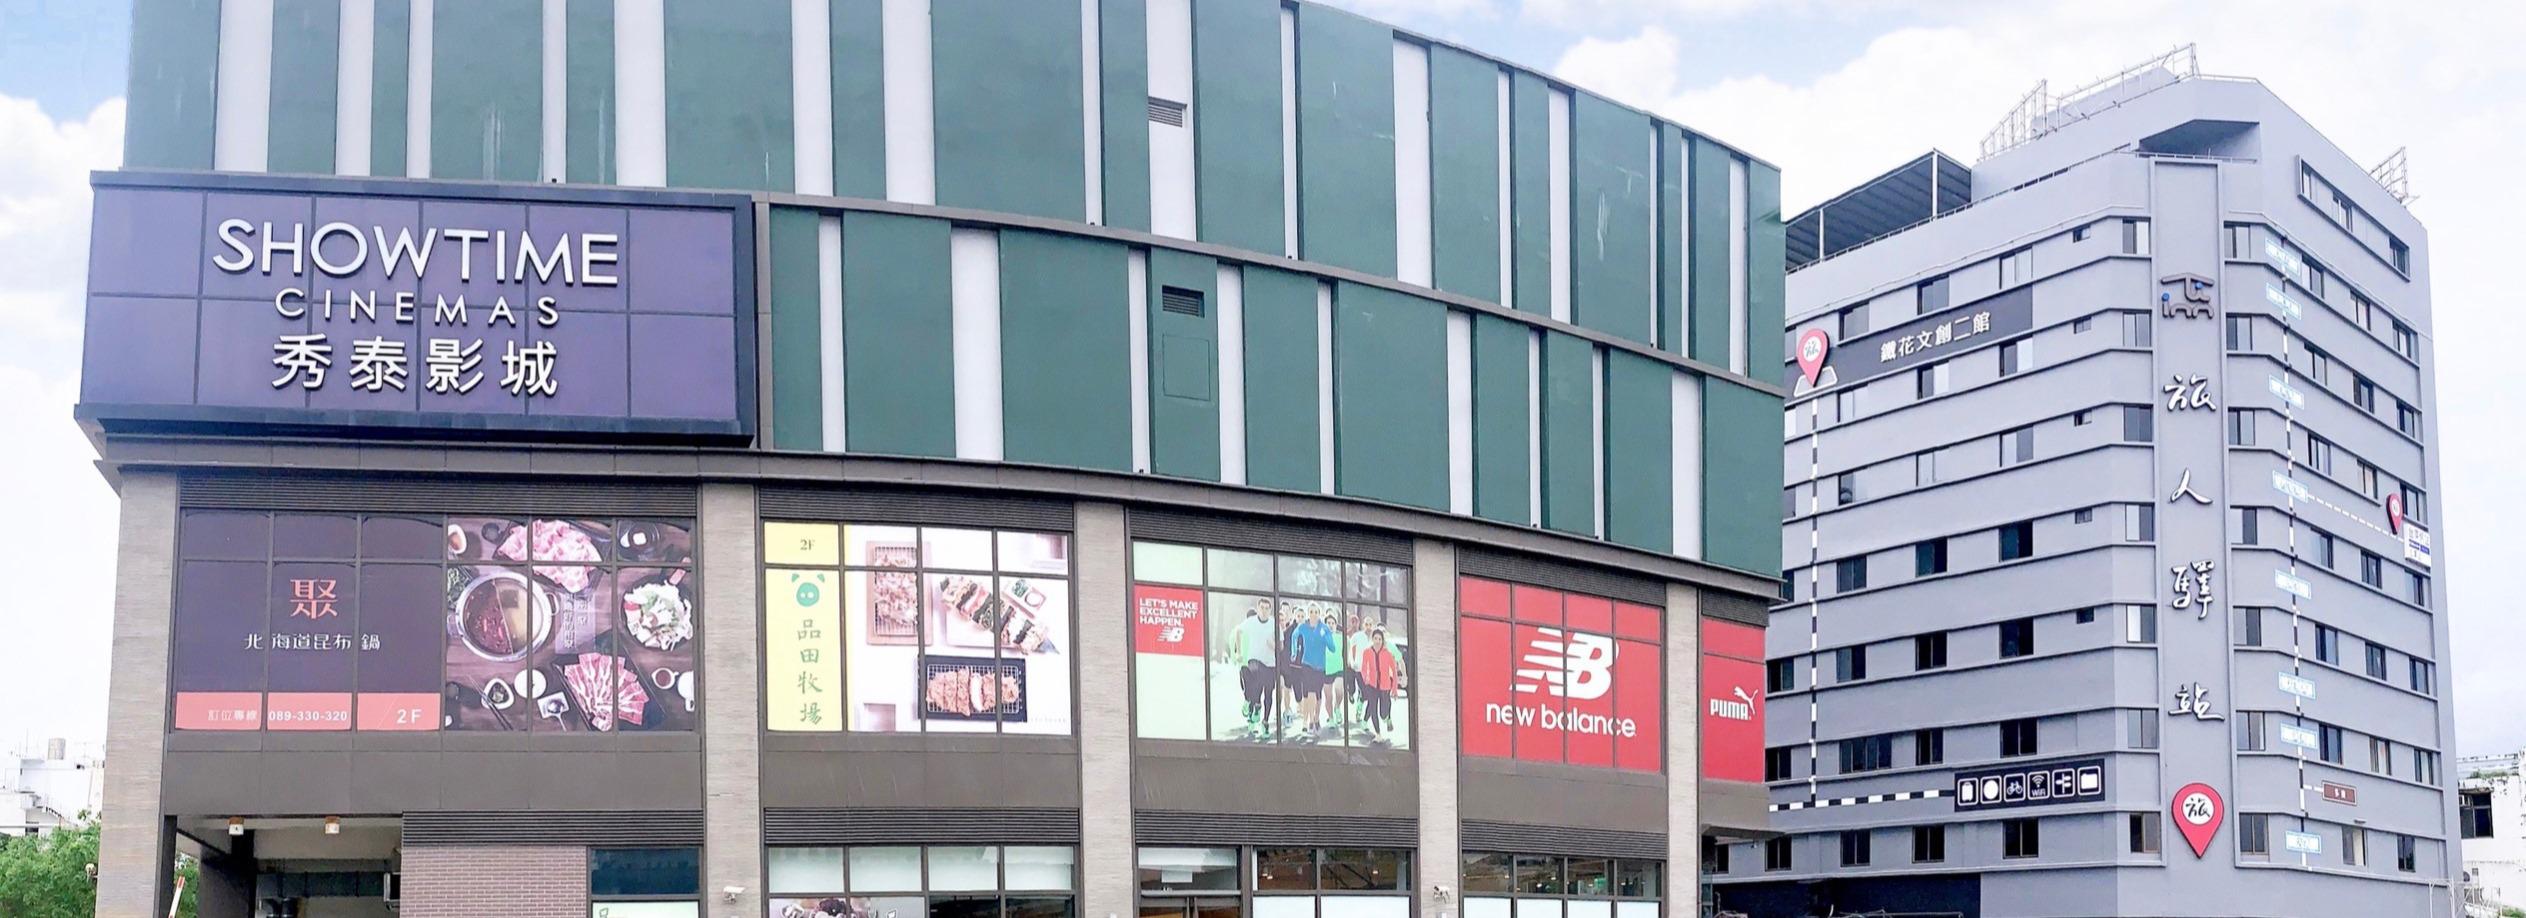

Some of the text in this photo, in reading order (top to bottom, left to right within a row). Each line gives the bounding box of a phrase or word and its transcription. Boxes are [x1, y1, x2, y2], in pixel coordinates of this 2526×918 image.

[213, 218, 619, 286] SHOWTIME
[275, 287, 560, 326] CINEMAS
[1880, 311, 1992, 363] 鐵花文創二館
[272, 333, 559, 396] 秀泰影城
[799, 538, 816, 551] 2F
[290, 579, 338, 619] 聚
[1139, 597, 1199, 611] LET'S MAKE
[1139, 606, 1198, 620] EXCELLENT
[244, 633, 381, 651] 北海道昆布鍋
[797, 618, 823, 725] 品田牧場
[268, 710, 348, 722] 089-330-320
[396, 708, 423, 724] 2F
[1486, 703, 1637, 738] new balance
[1710, 698, 1751, 721] PUMA
[2185, 798, 2211, 818] 旅
